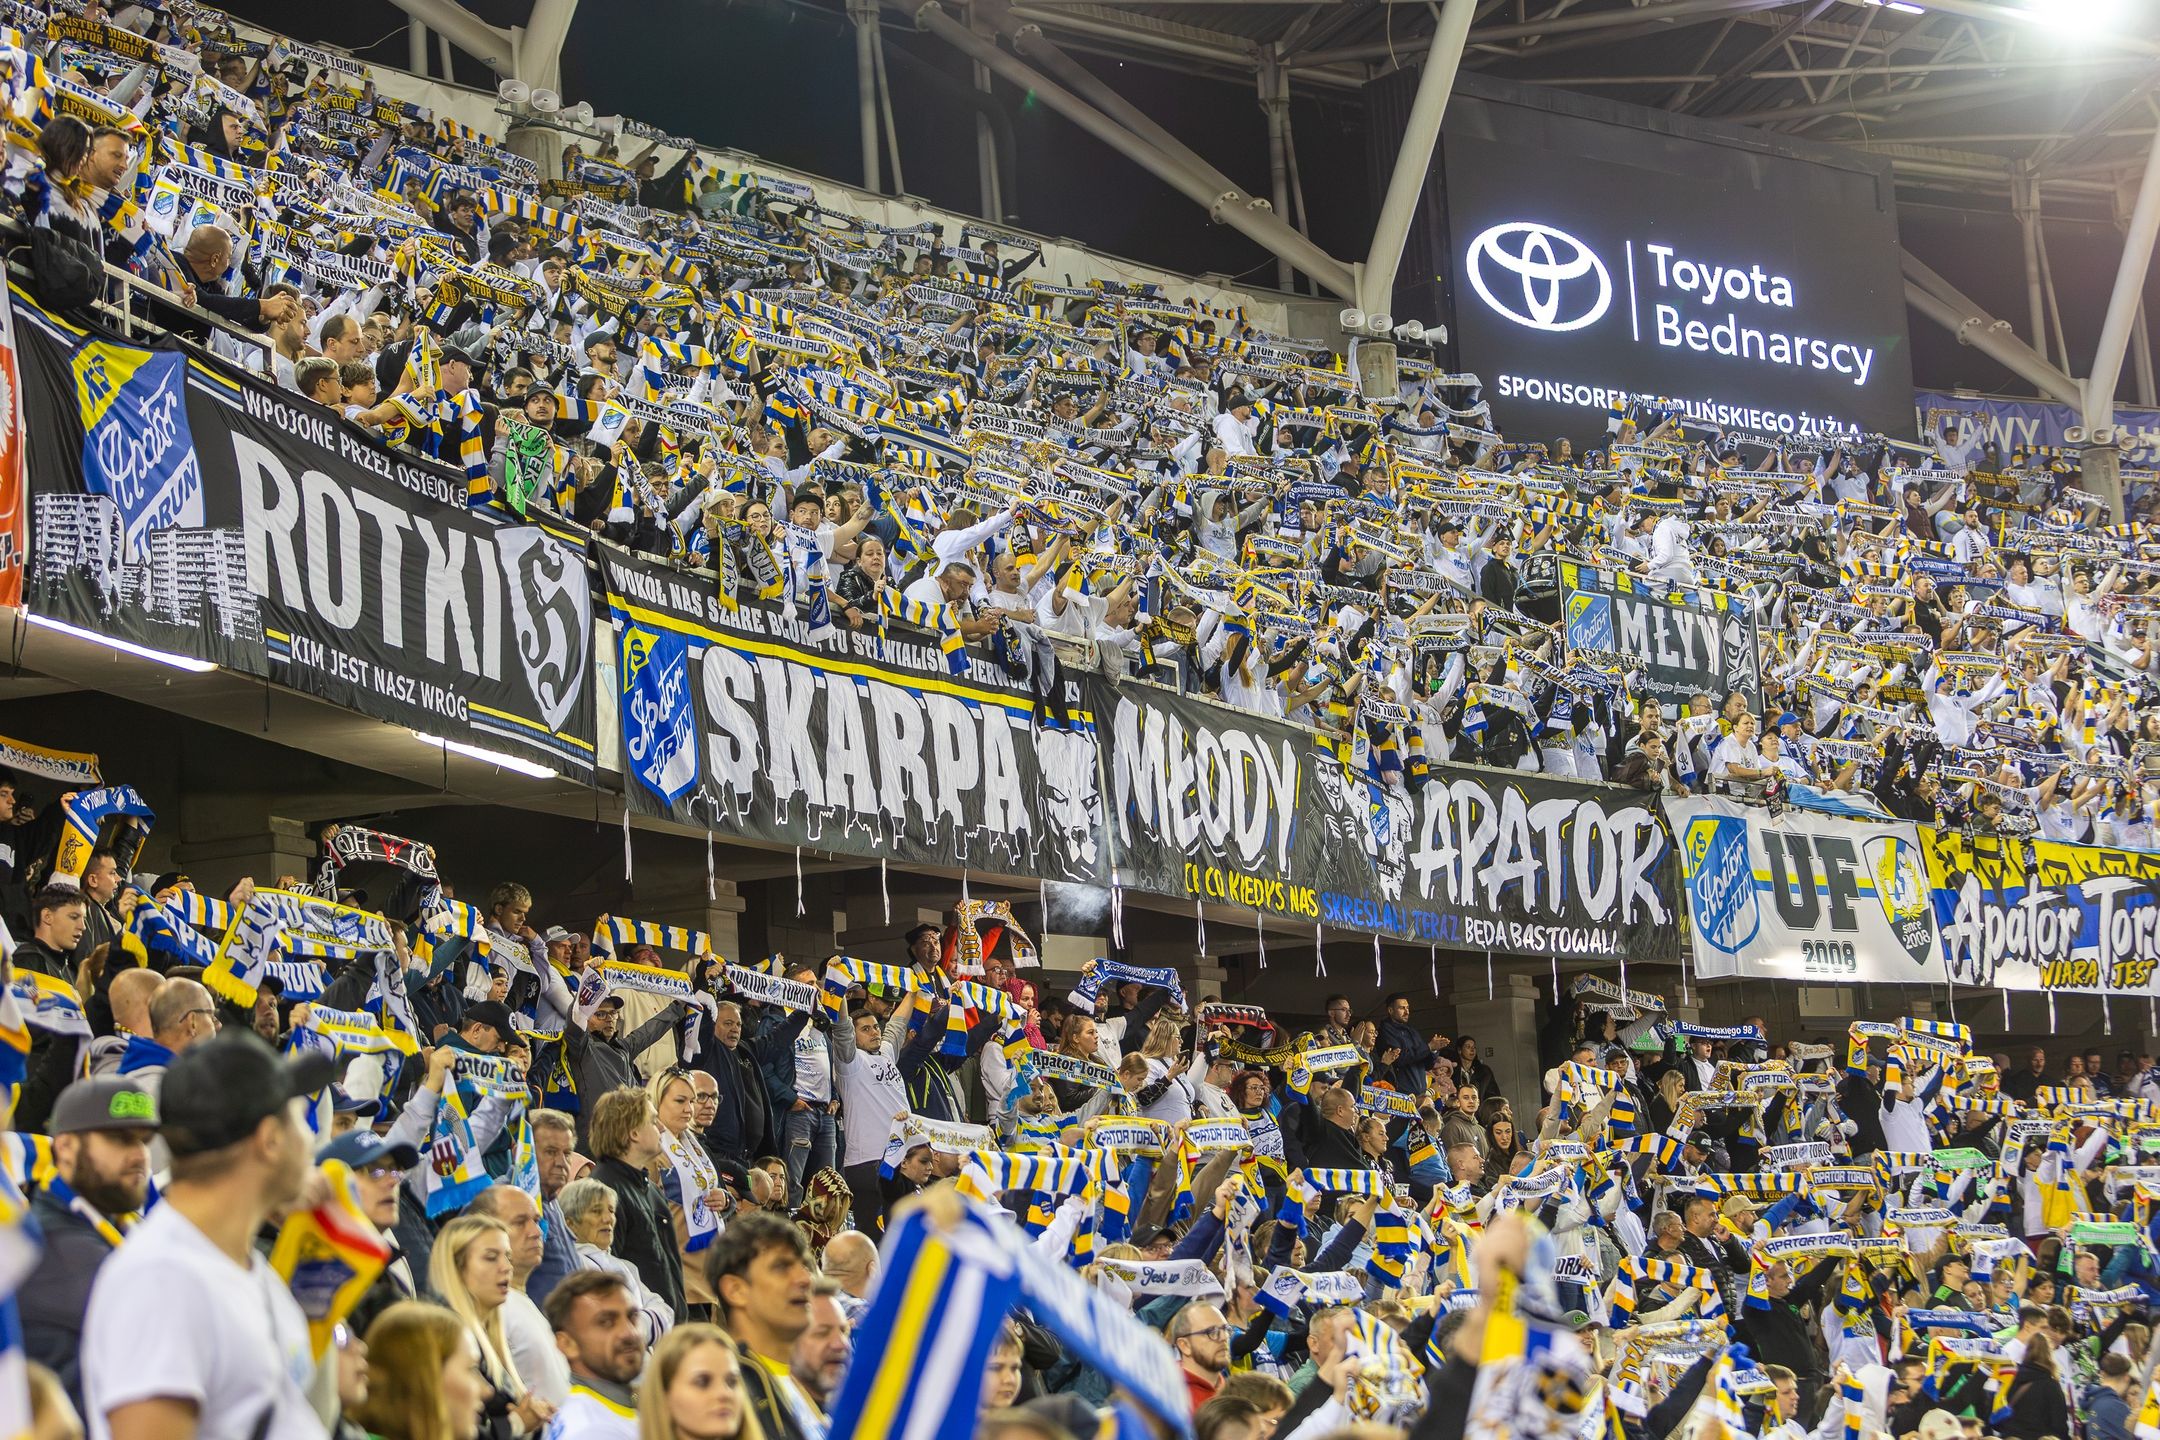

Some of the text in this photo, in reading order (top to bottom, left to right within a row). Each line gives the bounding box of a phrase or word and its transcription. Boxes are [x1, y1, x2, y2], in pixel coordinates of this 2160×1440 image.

[1033, 282, 1066, 294] APATOR
[1647, 244, 1794, 308] Toyota
[1124, 301, 1160, 312] APATOR
[756, 330, 792, 347] APATOR
[1654, 305, 1874, 386] Bednarscy
[241, 386, 335, 453] WPOJONE
[341, 431, 391, 483] PRZEZ
[232, 429, 502, 683] ROTKI
[609, 560, 667, 605] WOKÓŁ
[671, 582, 704, 618] NAS
[830, 630, 849, 656] TU
[289, 632, 469, 722] KIM JEST NASZ WRÓG
[702, 641, 1034, 835] SKARPA
[1111, 696, 1298, 875] MŁODY
[1411, 780, 1679, 927] APATOR
[1690, 832, 1706, 866] KS
[1760, 829, 1860, 932] UF
[1205, 866, 1225, 897] CO
[1228, 870, 1285, 910] KIEDYŚ
[1289, 885, 1319, 918] NAS
[1412, 911, 1460, 942] TERAZ
[1510, 922, 1617, 954] BASTOWALI
[1903, 930, 1931, 949] 2008
[1942, 869, 2081, 988] Apator
[1801, 940, 1856, 973] 2008
[2112, 958, 2157, 989] JEST
[729, 970, 813, 1005] APATOR TORUN
[1741, 1024, 1753, 1035] 98
[1031, 1048, 1076, 1073] Apator
[1770, 1146, 1798, 1165] APATOR
[1813, 1170, 1844, 1185] APATOR
[1766, 1235, 1815, 1254] APATOR
